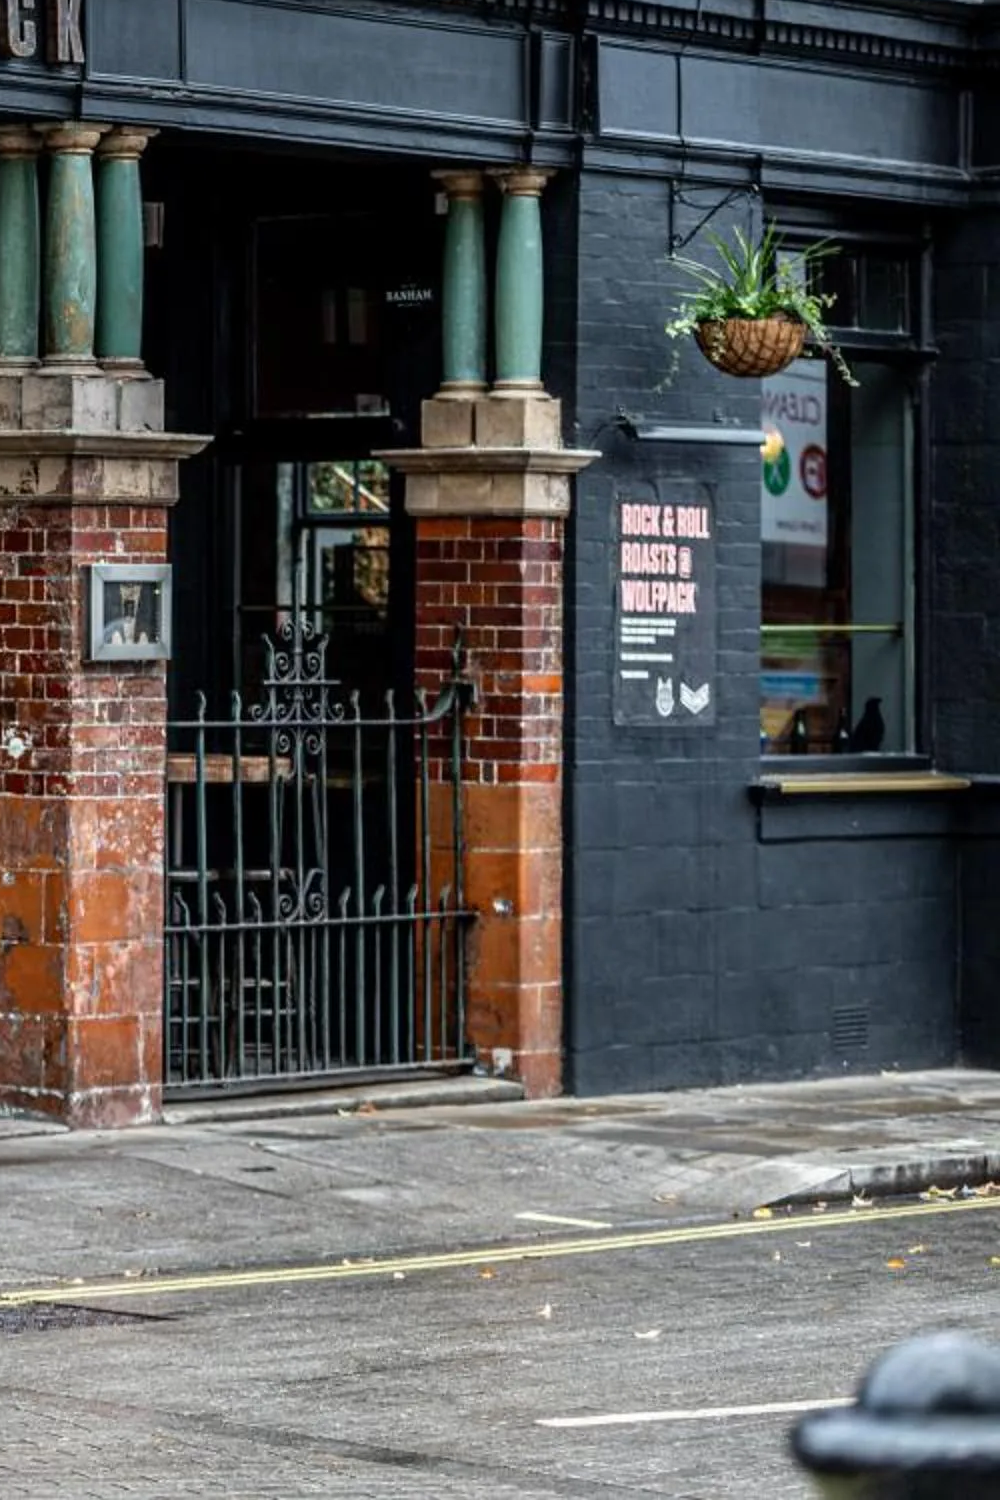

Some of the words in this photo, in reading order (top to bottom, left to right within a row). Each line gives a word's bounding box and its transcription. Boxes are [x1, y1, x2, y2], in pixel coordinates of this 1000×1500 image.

[621, 503, 661, 536] ROCK
[662, 504, 675, 537] &
[677, 506, 711, 539] ROLL
[621, 541, 677, 575] ROASTS
[621, 579, 697, 613] WOLFPACK
